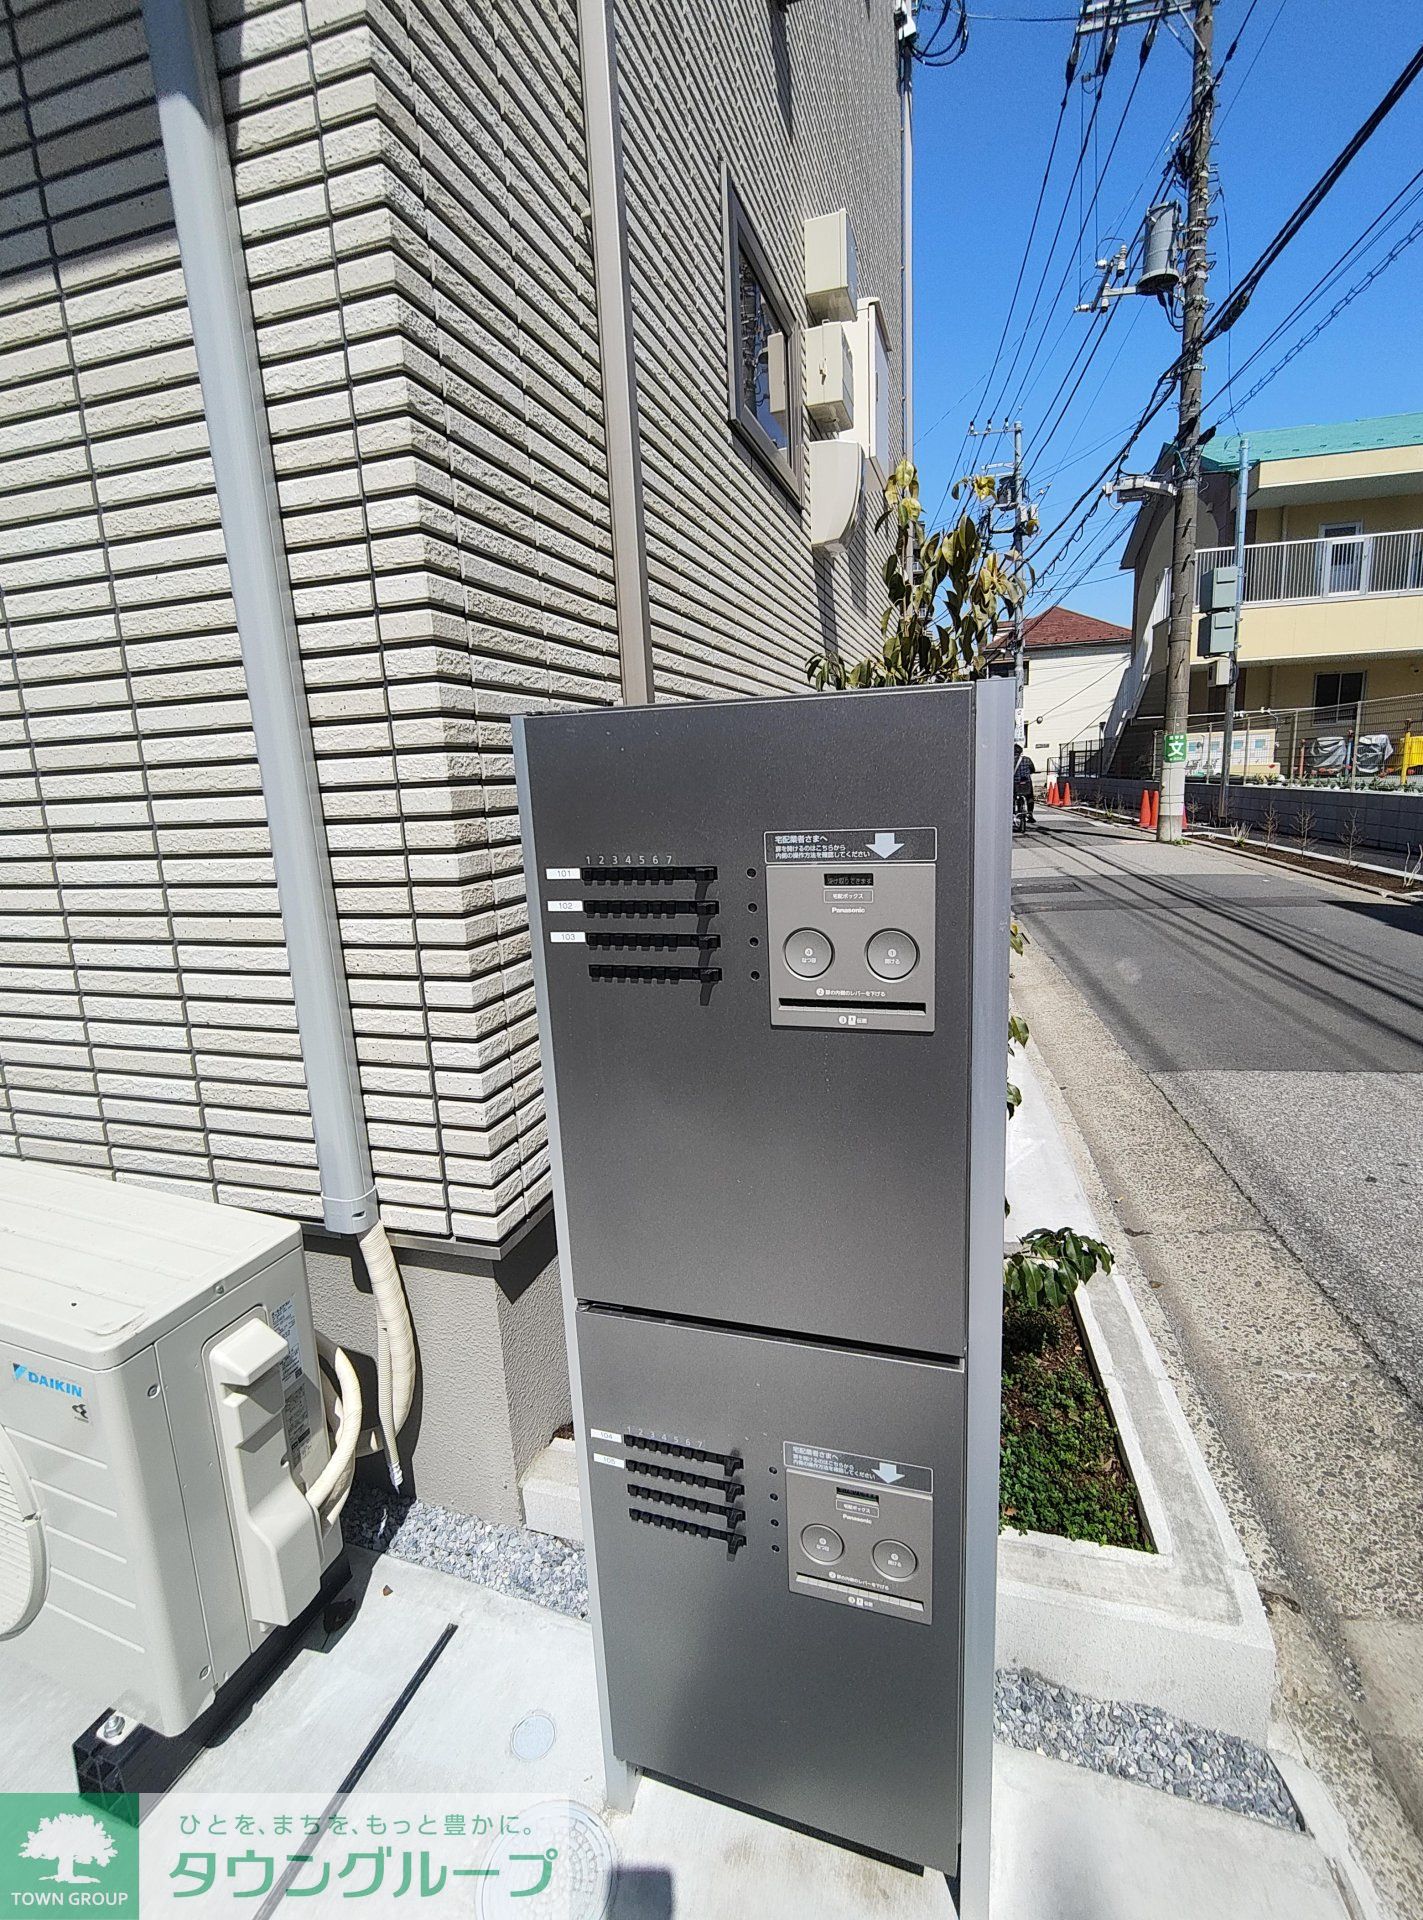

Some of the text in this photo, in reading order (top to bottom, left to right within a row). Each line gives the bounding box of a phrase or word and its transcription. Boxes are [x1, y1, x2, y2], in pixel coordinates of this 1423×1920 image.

[586, 856, 672, 864] 1 2 3 4 5 6 7
[832, 906, 866, 914] Panasonic
[28, 1371, 82, 1397] DAIKIN
[627, 1426, 631, 1434] 1
[638, 1428, 643, 1436] 2
[650, 1431, 655, 1439] 3
[685, 1438, 691, 1446] 6
[842, 1513, 873, 1524] Panasonic
